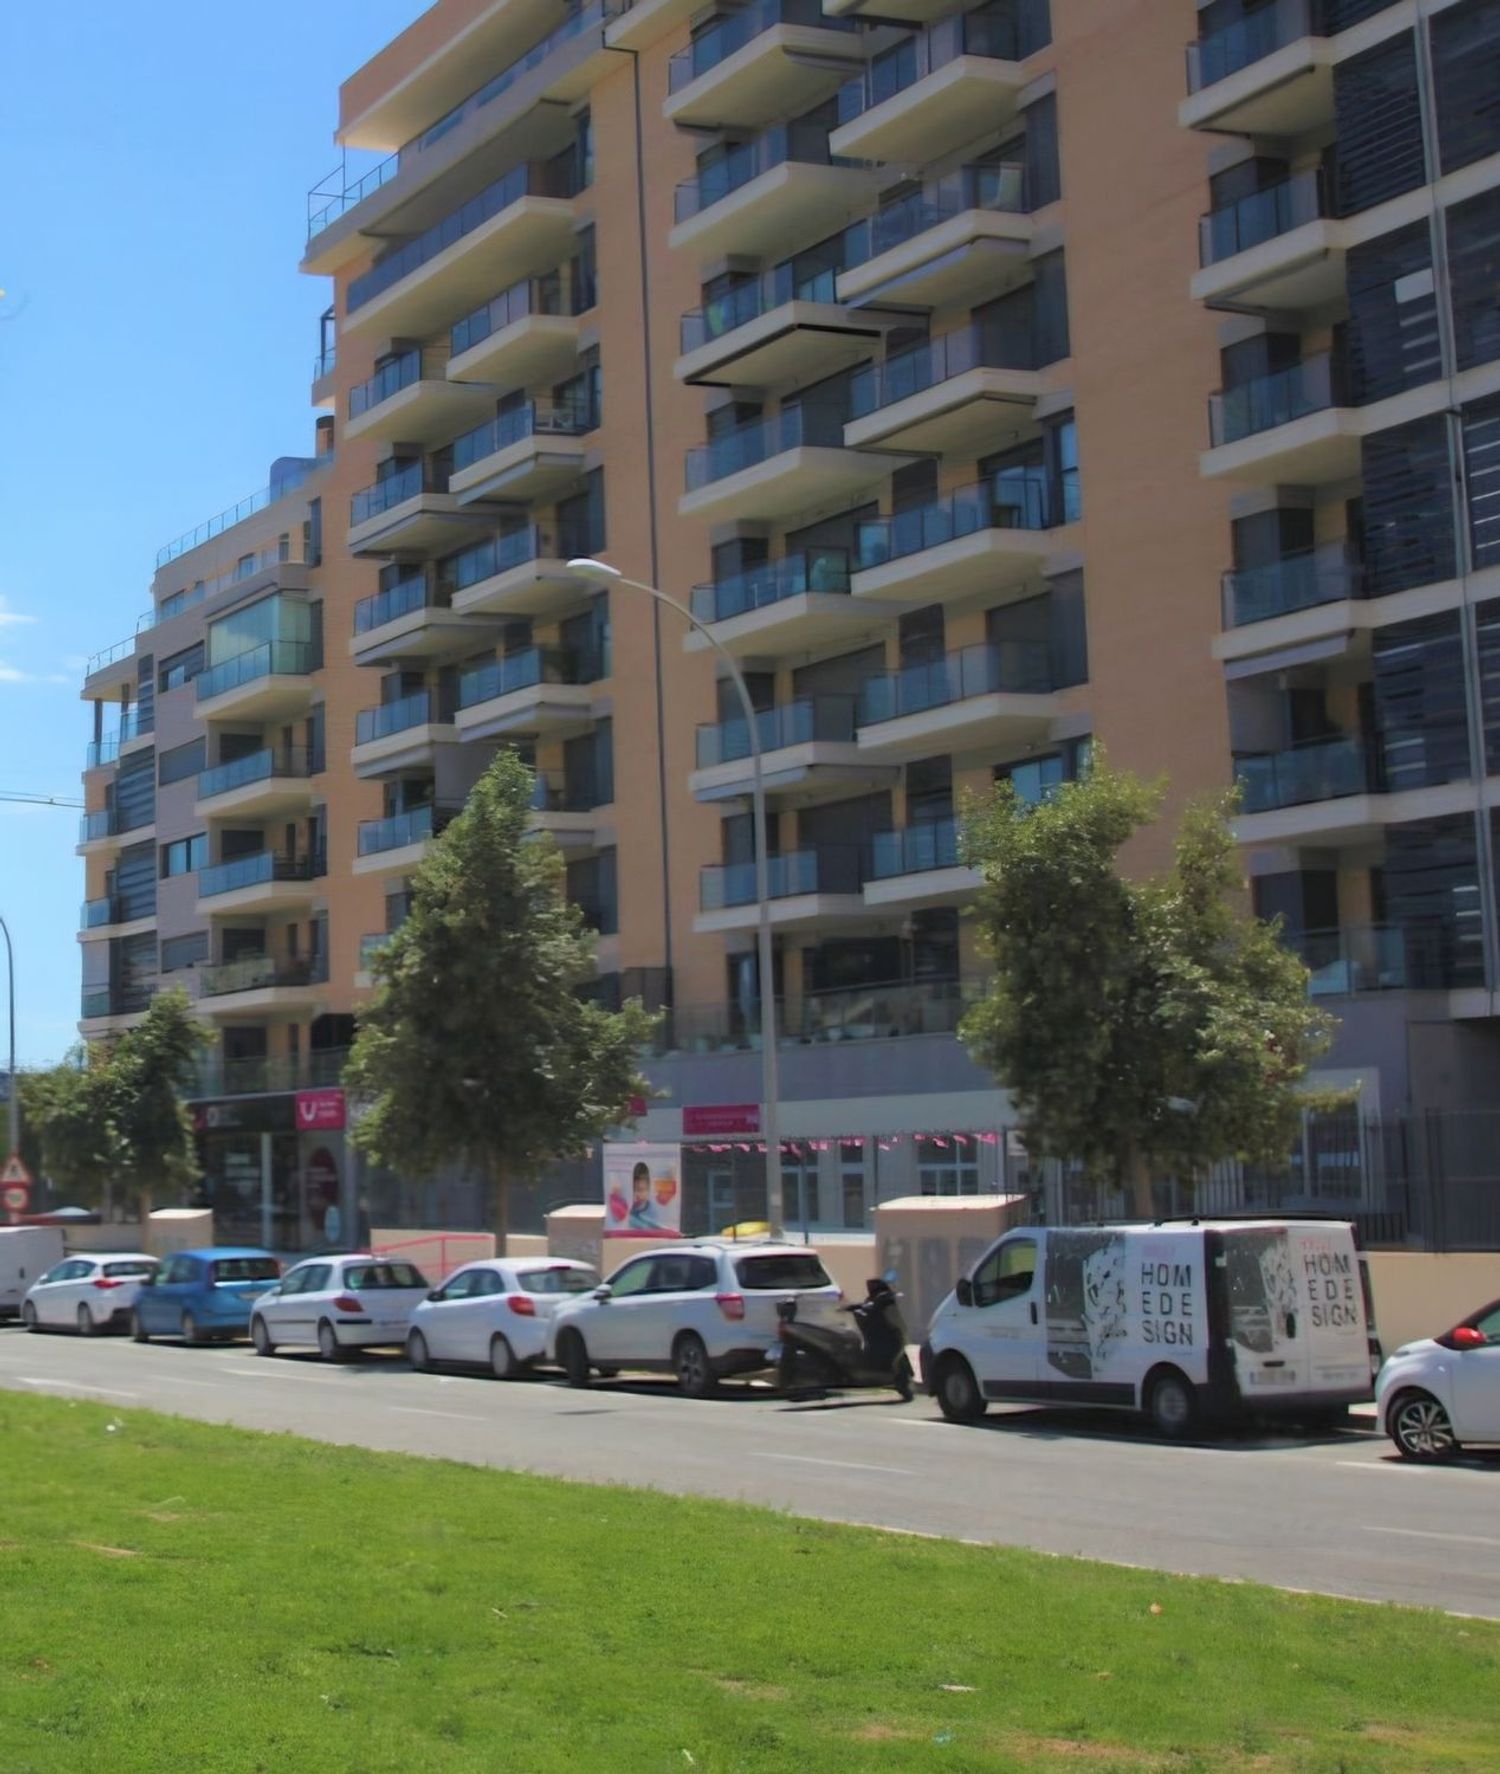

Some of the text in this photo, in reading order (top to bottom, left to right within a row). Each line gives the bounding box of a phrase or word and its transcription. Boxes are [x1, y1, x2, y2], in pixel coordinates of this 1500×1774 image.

[1141, 1263, 1191, 1288] HOM
[1304, 1252, 1351, 1276] HOM
[1308, 1279, 1353, 1300] EDE
[1142, 1291, 1192, 1316] EDE
[1312, 1304, 1357, 1327] SIGN
[1142, 1320, 1193, 1345] SIGN
